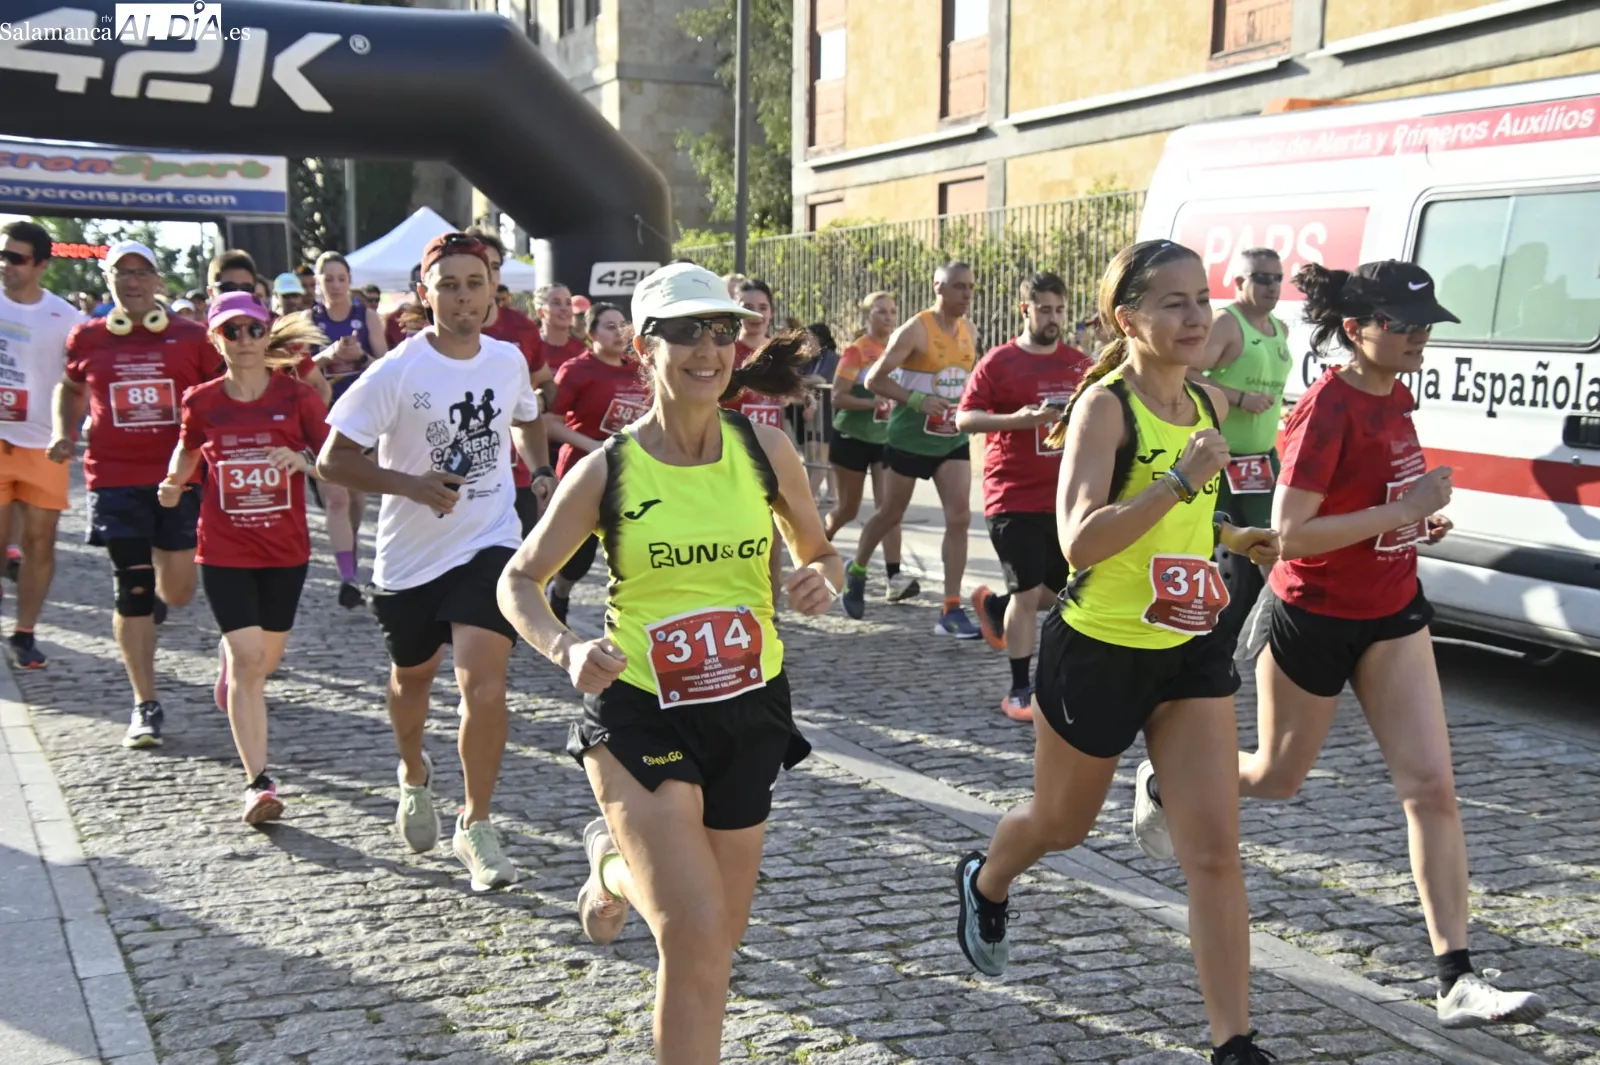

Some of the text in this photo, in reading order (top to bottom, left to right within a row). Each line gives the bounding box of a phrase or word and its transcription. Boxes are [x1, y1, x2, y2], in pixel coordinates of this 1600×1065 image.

[0, 6, 343, 113] 42K
[1391, 119, 1491, 148] Primeros
[1492, 105, 1597, 139] Auxilios
[127, 386, 160, 405] 88
[1451, 356, 1600, 418] Española
[748, 410, 778, 425] 414
[229, 467, 281, 489] 340
[1236, 460, 1263, 477] 75
[665, 617, 752, 664] 314
